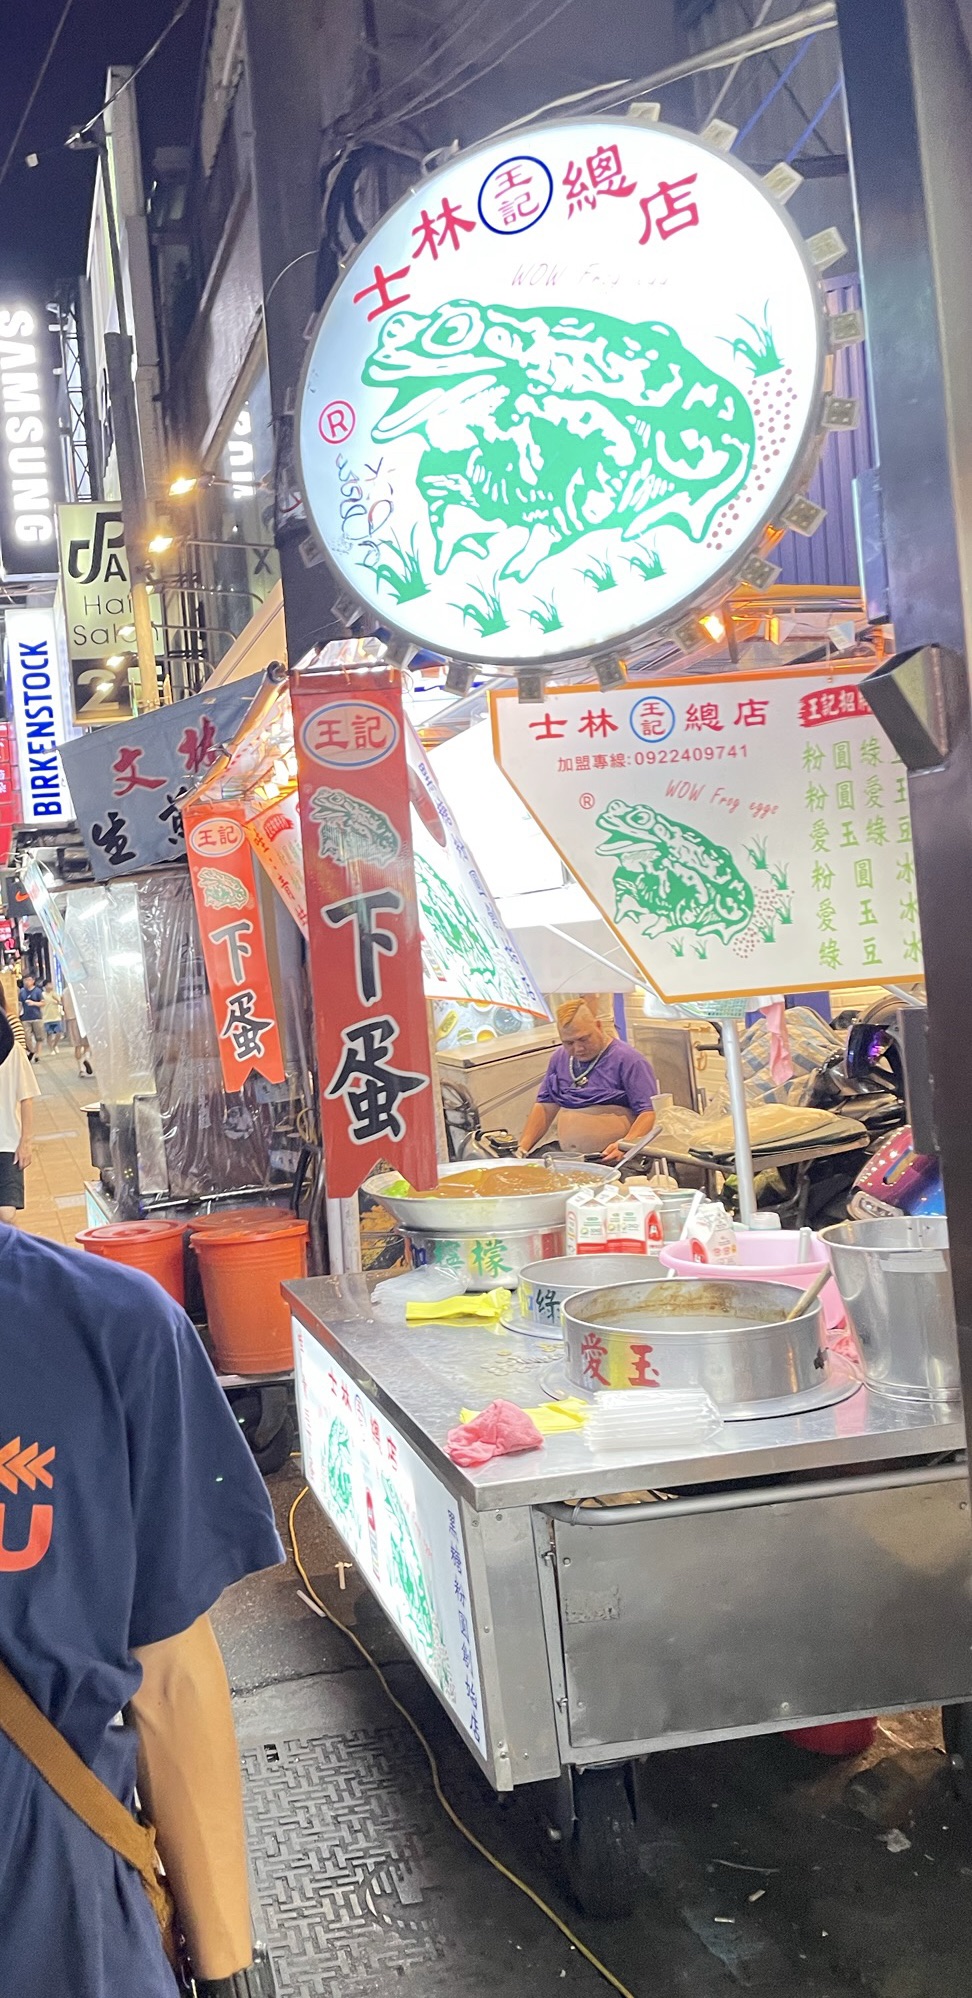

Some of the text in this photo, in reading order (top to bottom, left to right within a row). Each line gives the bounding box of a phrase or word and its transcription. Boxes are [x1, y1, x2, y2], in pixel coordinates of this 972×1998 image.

[353, 197, 477, 322] 士林
[561, 144, 700, 246] 總店
[0, 307, 53, 542] SAMSUNG
[84, 595, 133, 616] Hai
[18, 640, 63, 817] BIRKENSTOCK
[314, 716, 388, 751] 王記
[528, 707, 619, 741] 士林
[684, 698, 769, 732] 總店
[802, 735, 904, 771] 粉圓綠
[665, 779, 706, 802] WOW
[710, 787, 740, 814] Frog
[196, 825, 242, 847] 王記
[209, 919, 273, 1060] 下蛋
[324, 890, 428, 1142] 下蛋
[581, 1332, 660, 1388] 愛玉
